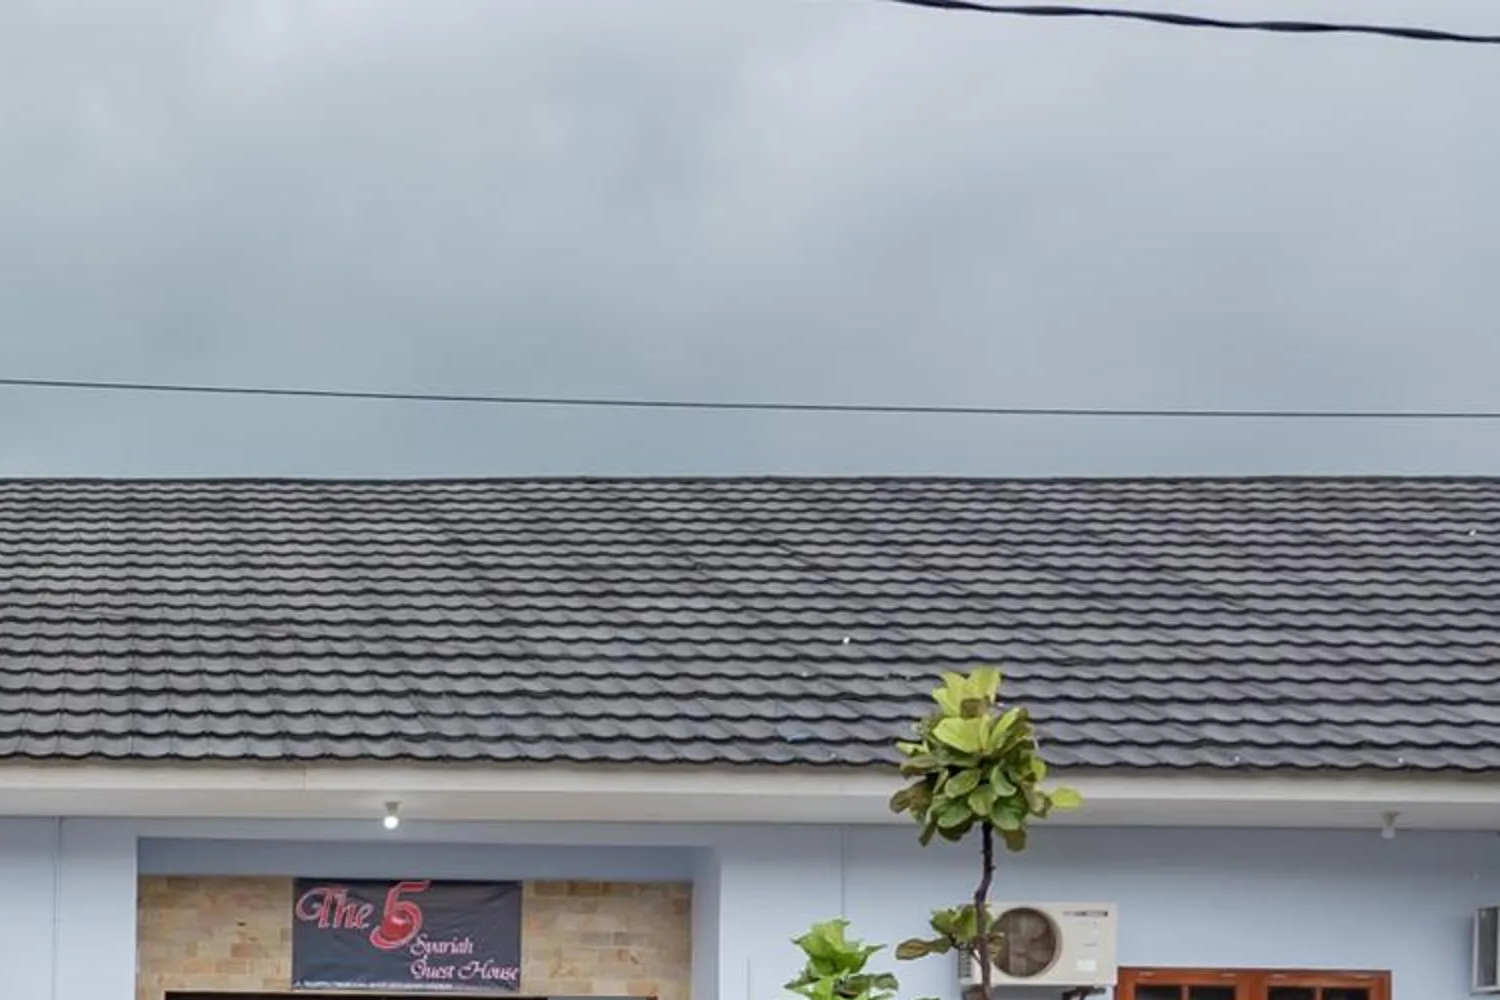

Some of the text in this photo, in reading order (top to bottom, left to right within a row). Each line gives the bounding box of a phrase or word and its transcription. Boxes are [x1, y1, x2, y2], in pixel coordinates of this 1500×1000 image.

[296, 880, 431, 949] The 5
[458, 959, 519, 980] House
